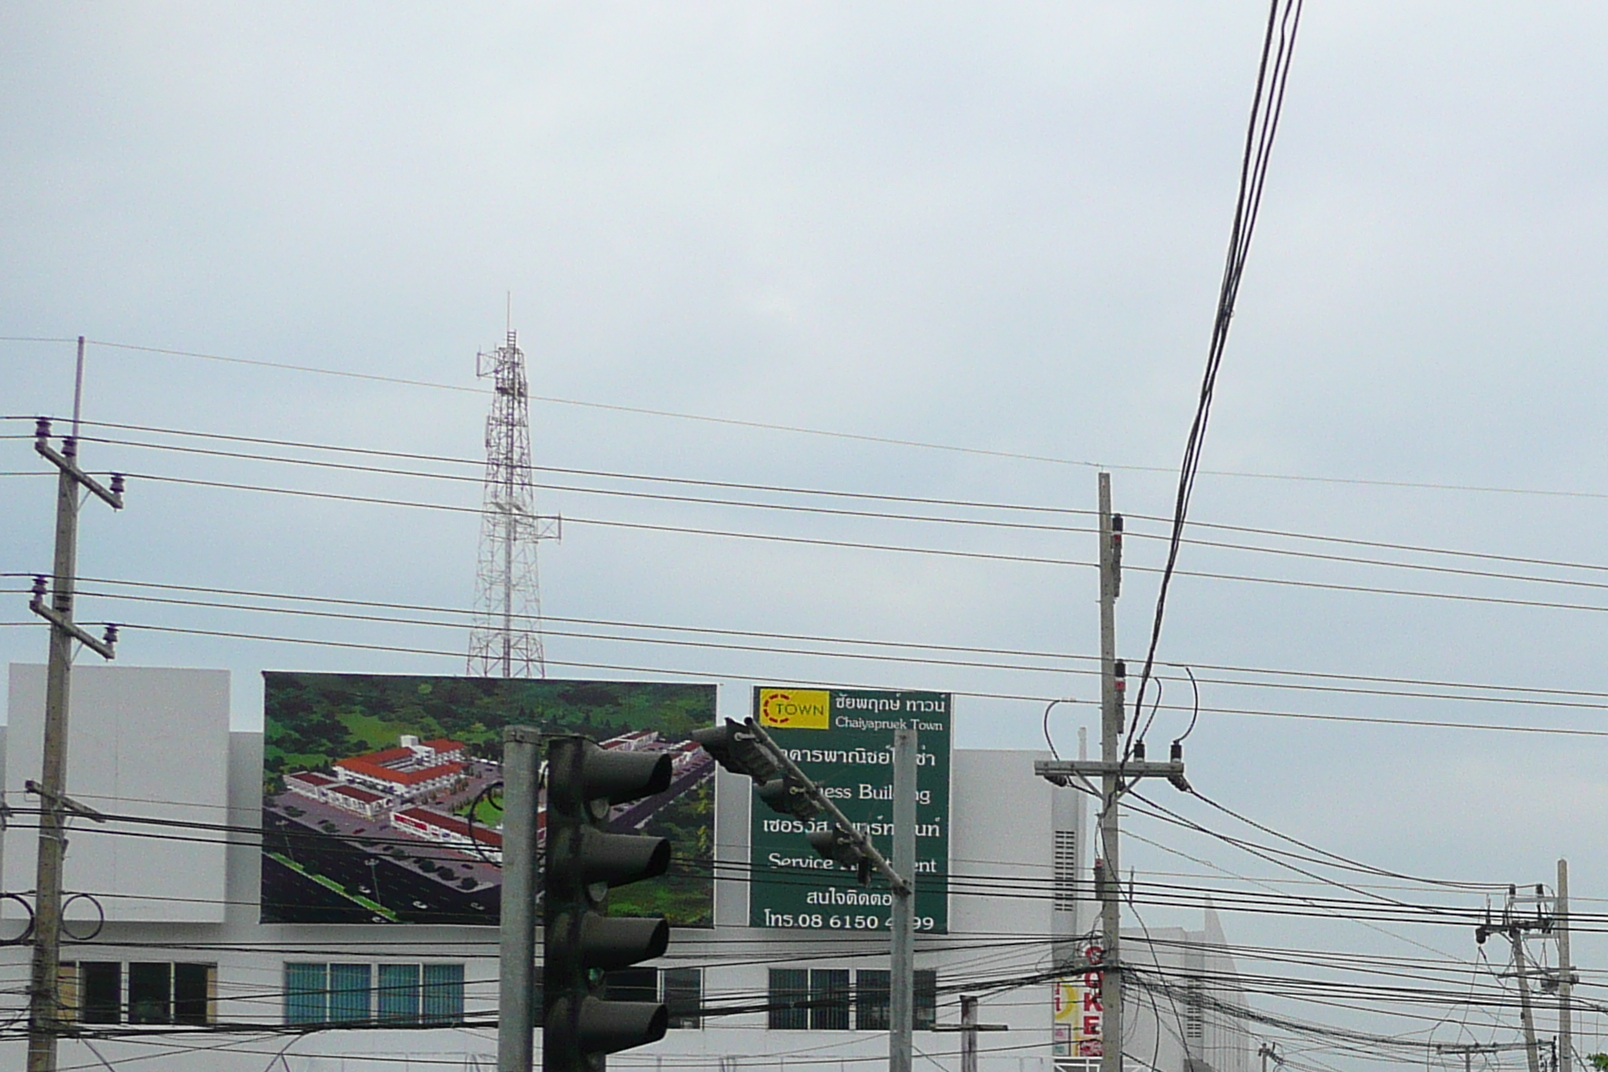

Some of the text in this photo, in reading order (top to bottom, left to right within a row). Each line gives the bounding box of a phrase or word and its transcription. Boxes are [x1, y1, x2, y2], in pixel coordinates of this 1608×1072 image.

[776, 703, 824, 716] TOWN
[835, 693, 946, 713] ชัยพฤกษ์ ทาวน์
[835, 715, 943, 731] Chaiyapruek Town
[768, 852, 834, 869] Service
[829, 915, 879, 929] 6150
[885, 916, 934, 931] 499
